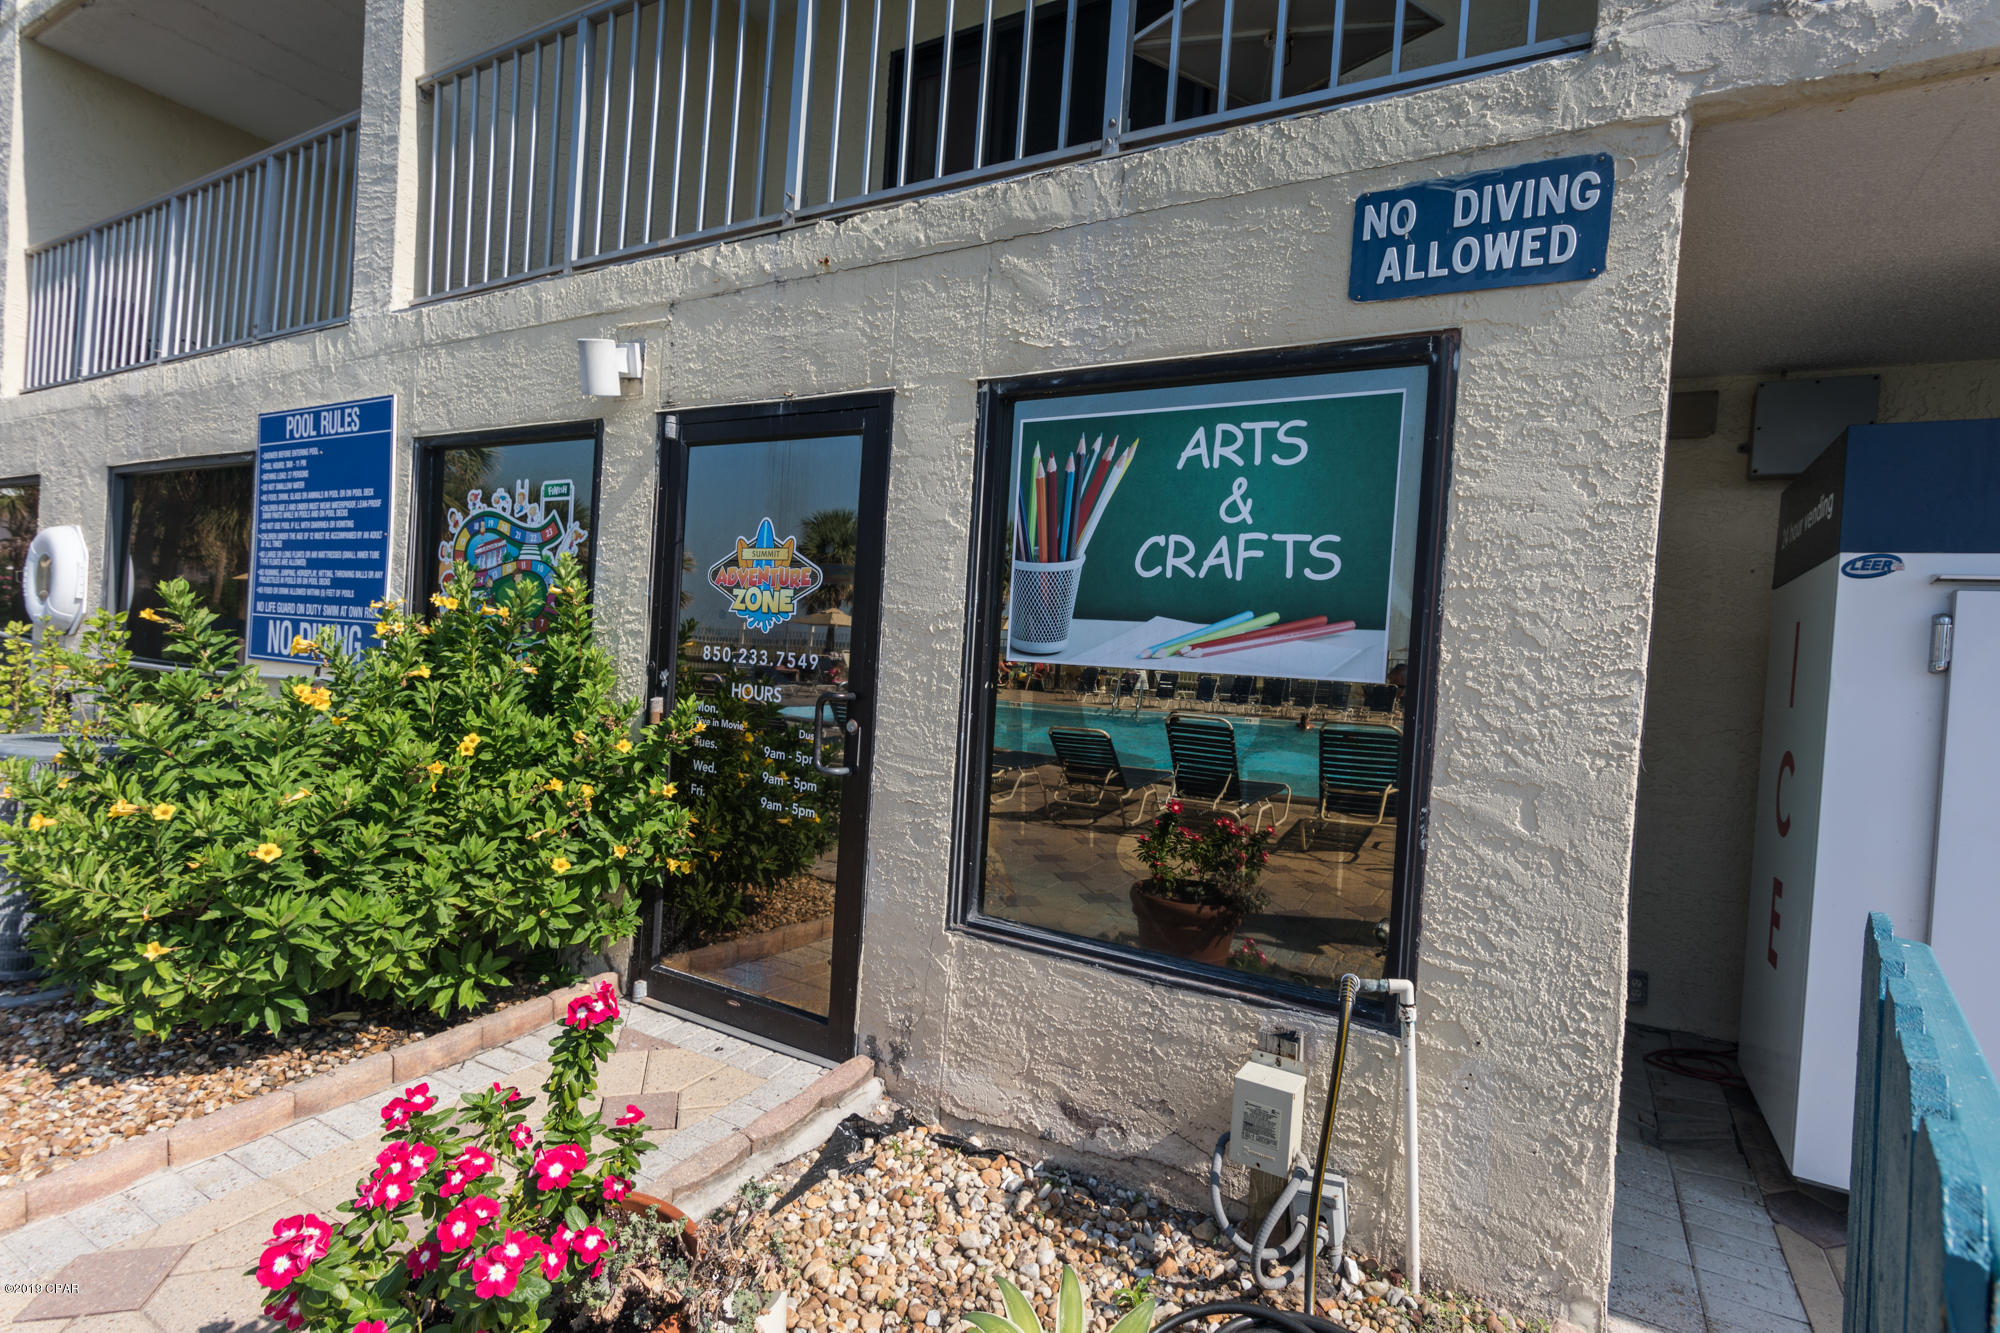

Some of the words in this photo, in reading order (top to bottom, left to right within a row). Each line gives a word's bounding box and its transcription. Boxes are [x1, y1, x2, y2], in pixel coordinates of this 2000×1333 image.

[1362, 199, 1417, 241] NO
[1453, 171, 1601, 228] DIVING
[1376, 224, 1578, 285] ALLOWED
[286, 413, 317, 439] POOL
[320, 407, 360, 435] RULES
[1177, 419, 1309, 470] ARTS
[1219, 476, 1254, 525] &
[1804, 492, 1834, 531] vending
[752, 550, 781, 558] SUMMIT
[1134, 532, 1342, 581] CRAFTS
[1849, 559, 1894, 572] LEER
[714, 566, 812, 589] ADVENTURE
[256, 600, 264, 612] NO
[265, 601, 276, 613] LIFE
[277, 602, 296, 614] GUARD
[296, 602, 305, 614] ON
[306, 604, 322, 616] DUTY
[322, 604, 340, 616] SWIM
[340, 606, 348, 617] AT
[348, 606, 364, 618] OWN
[730, 586, 795, 614] ZONE
[267, 619, 293, 656] NO
[702, 645, 819, 670] 850.233.7549
[731, 682, 782, 704] HOURS
[712, 717, 720, 727] in
[720, 719, 744, 730] Movie
[798, 730, 815, 741] Dus
[694, 735, 718, 749] Tues.
[764, 746, 786, 760] 9am
[692, 760, 717, 774] Wed.
[762, 771, 784, 787] 9am
[794, 778, 817, 793] 5pm
[690, 783, 706, 797] Fri.
[760, 797, 782, 812] 9am
[792, 804, 816, 819] 5pm
